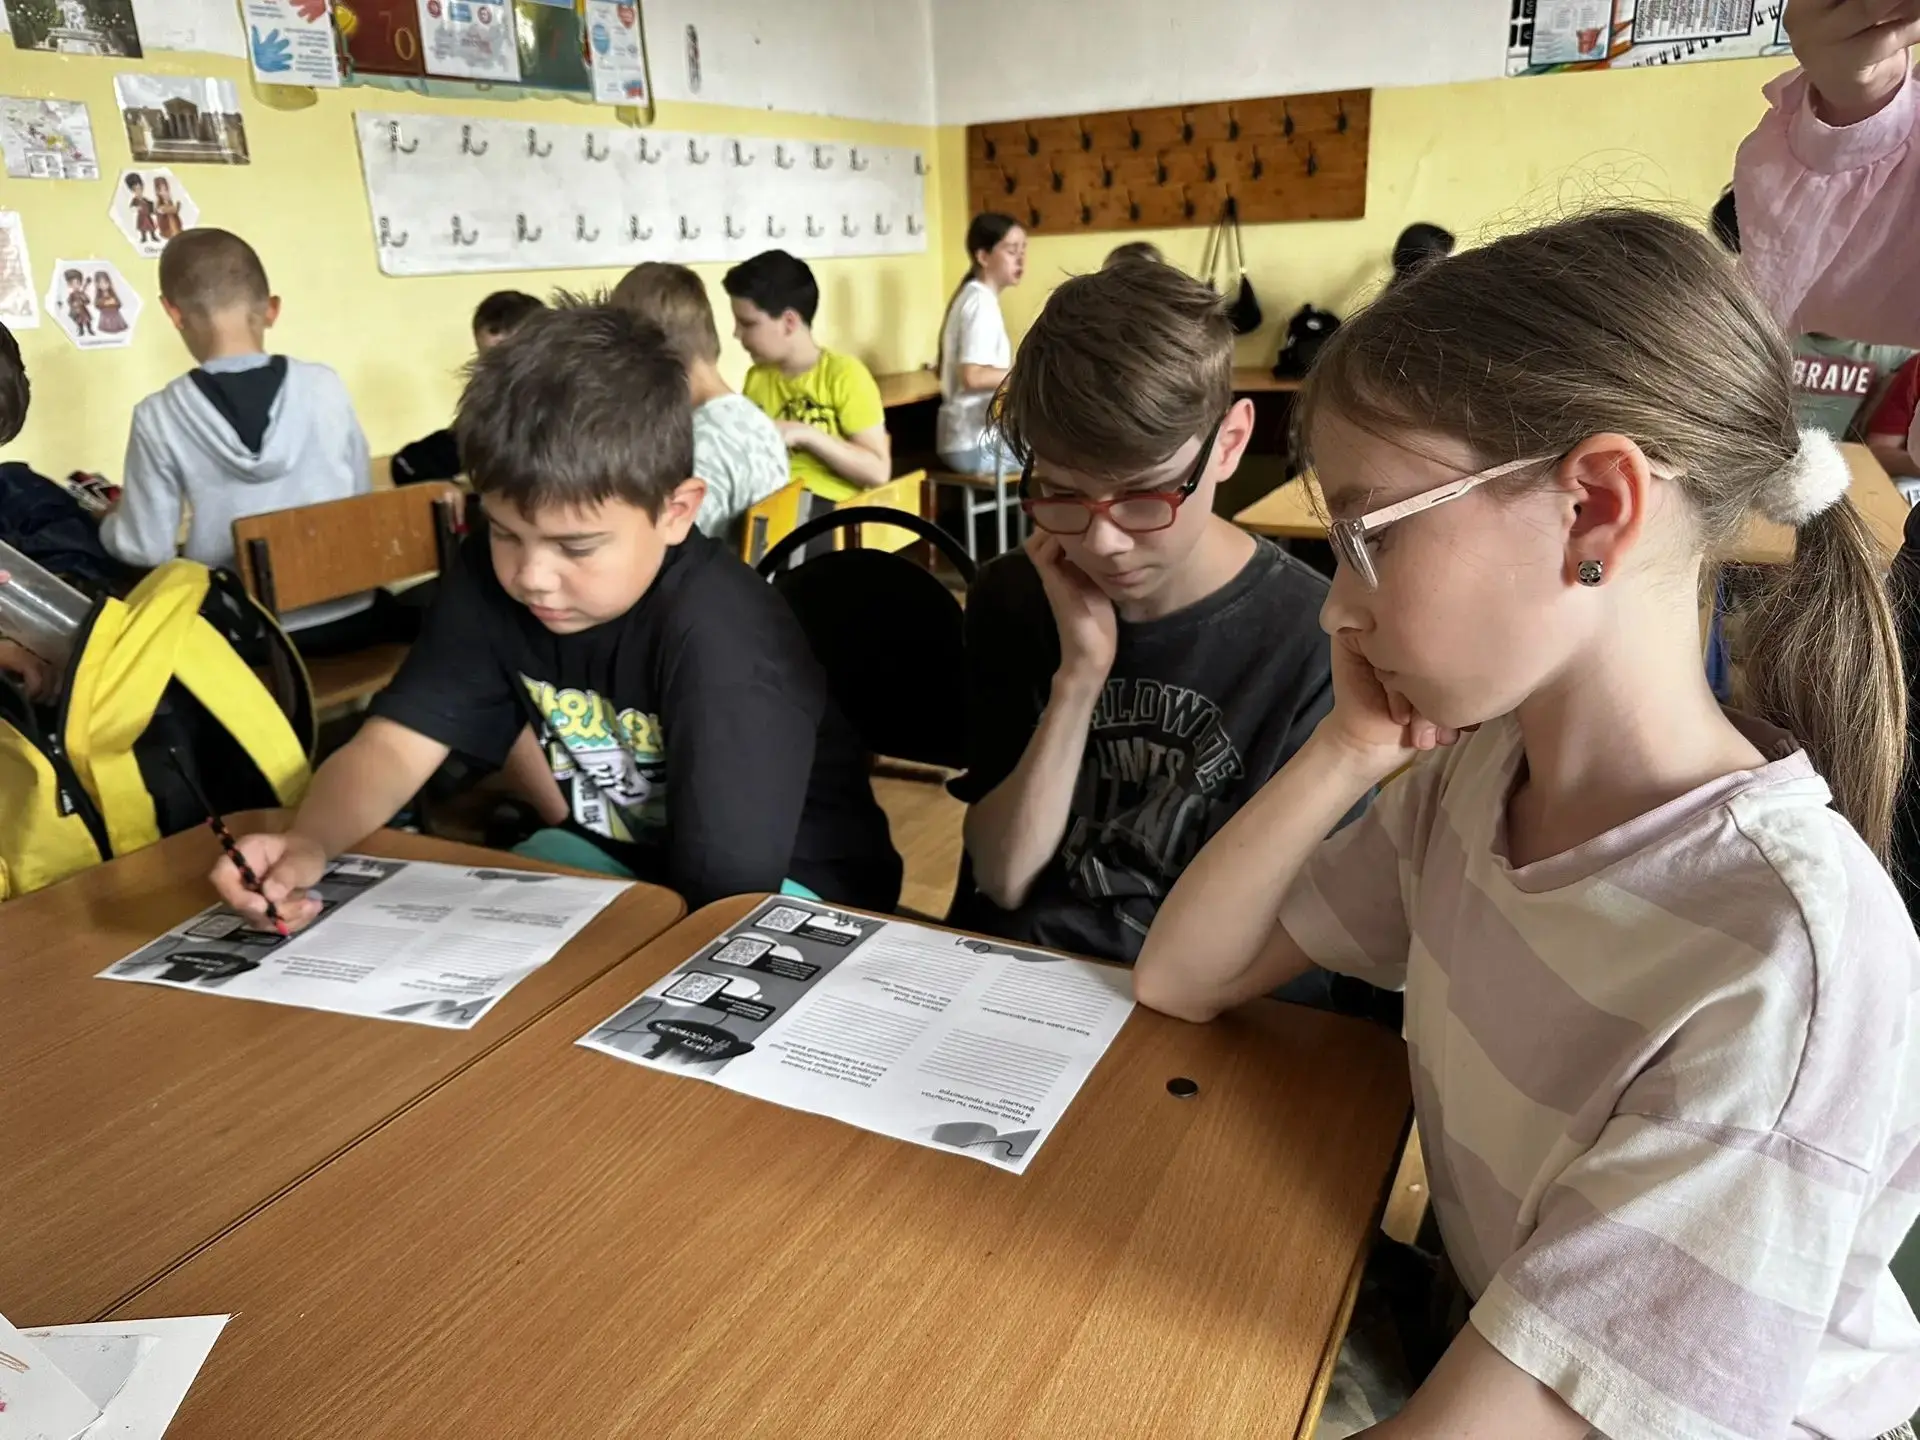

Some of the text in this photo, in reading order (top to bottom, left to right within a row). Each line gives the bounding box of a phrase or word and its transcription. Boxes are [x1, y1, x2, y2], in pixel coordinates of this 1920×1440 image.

[1792, 359, 1870, 394] BRAVE
[939, 1089, 983, 1104] просмотра
[968, 1104, 999, 1115] эмоции
[985, 1102, 1024, 1116] процессе
[1001, 1113, 1026, 1124] Какие
